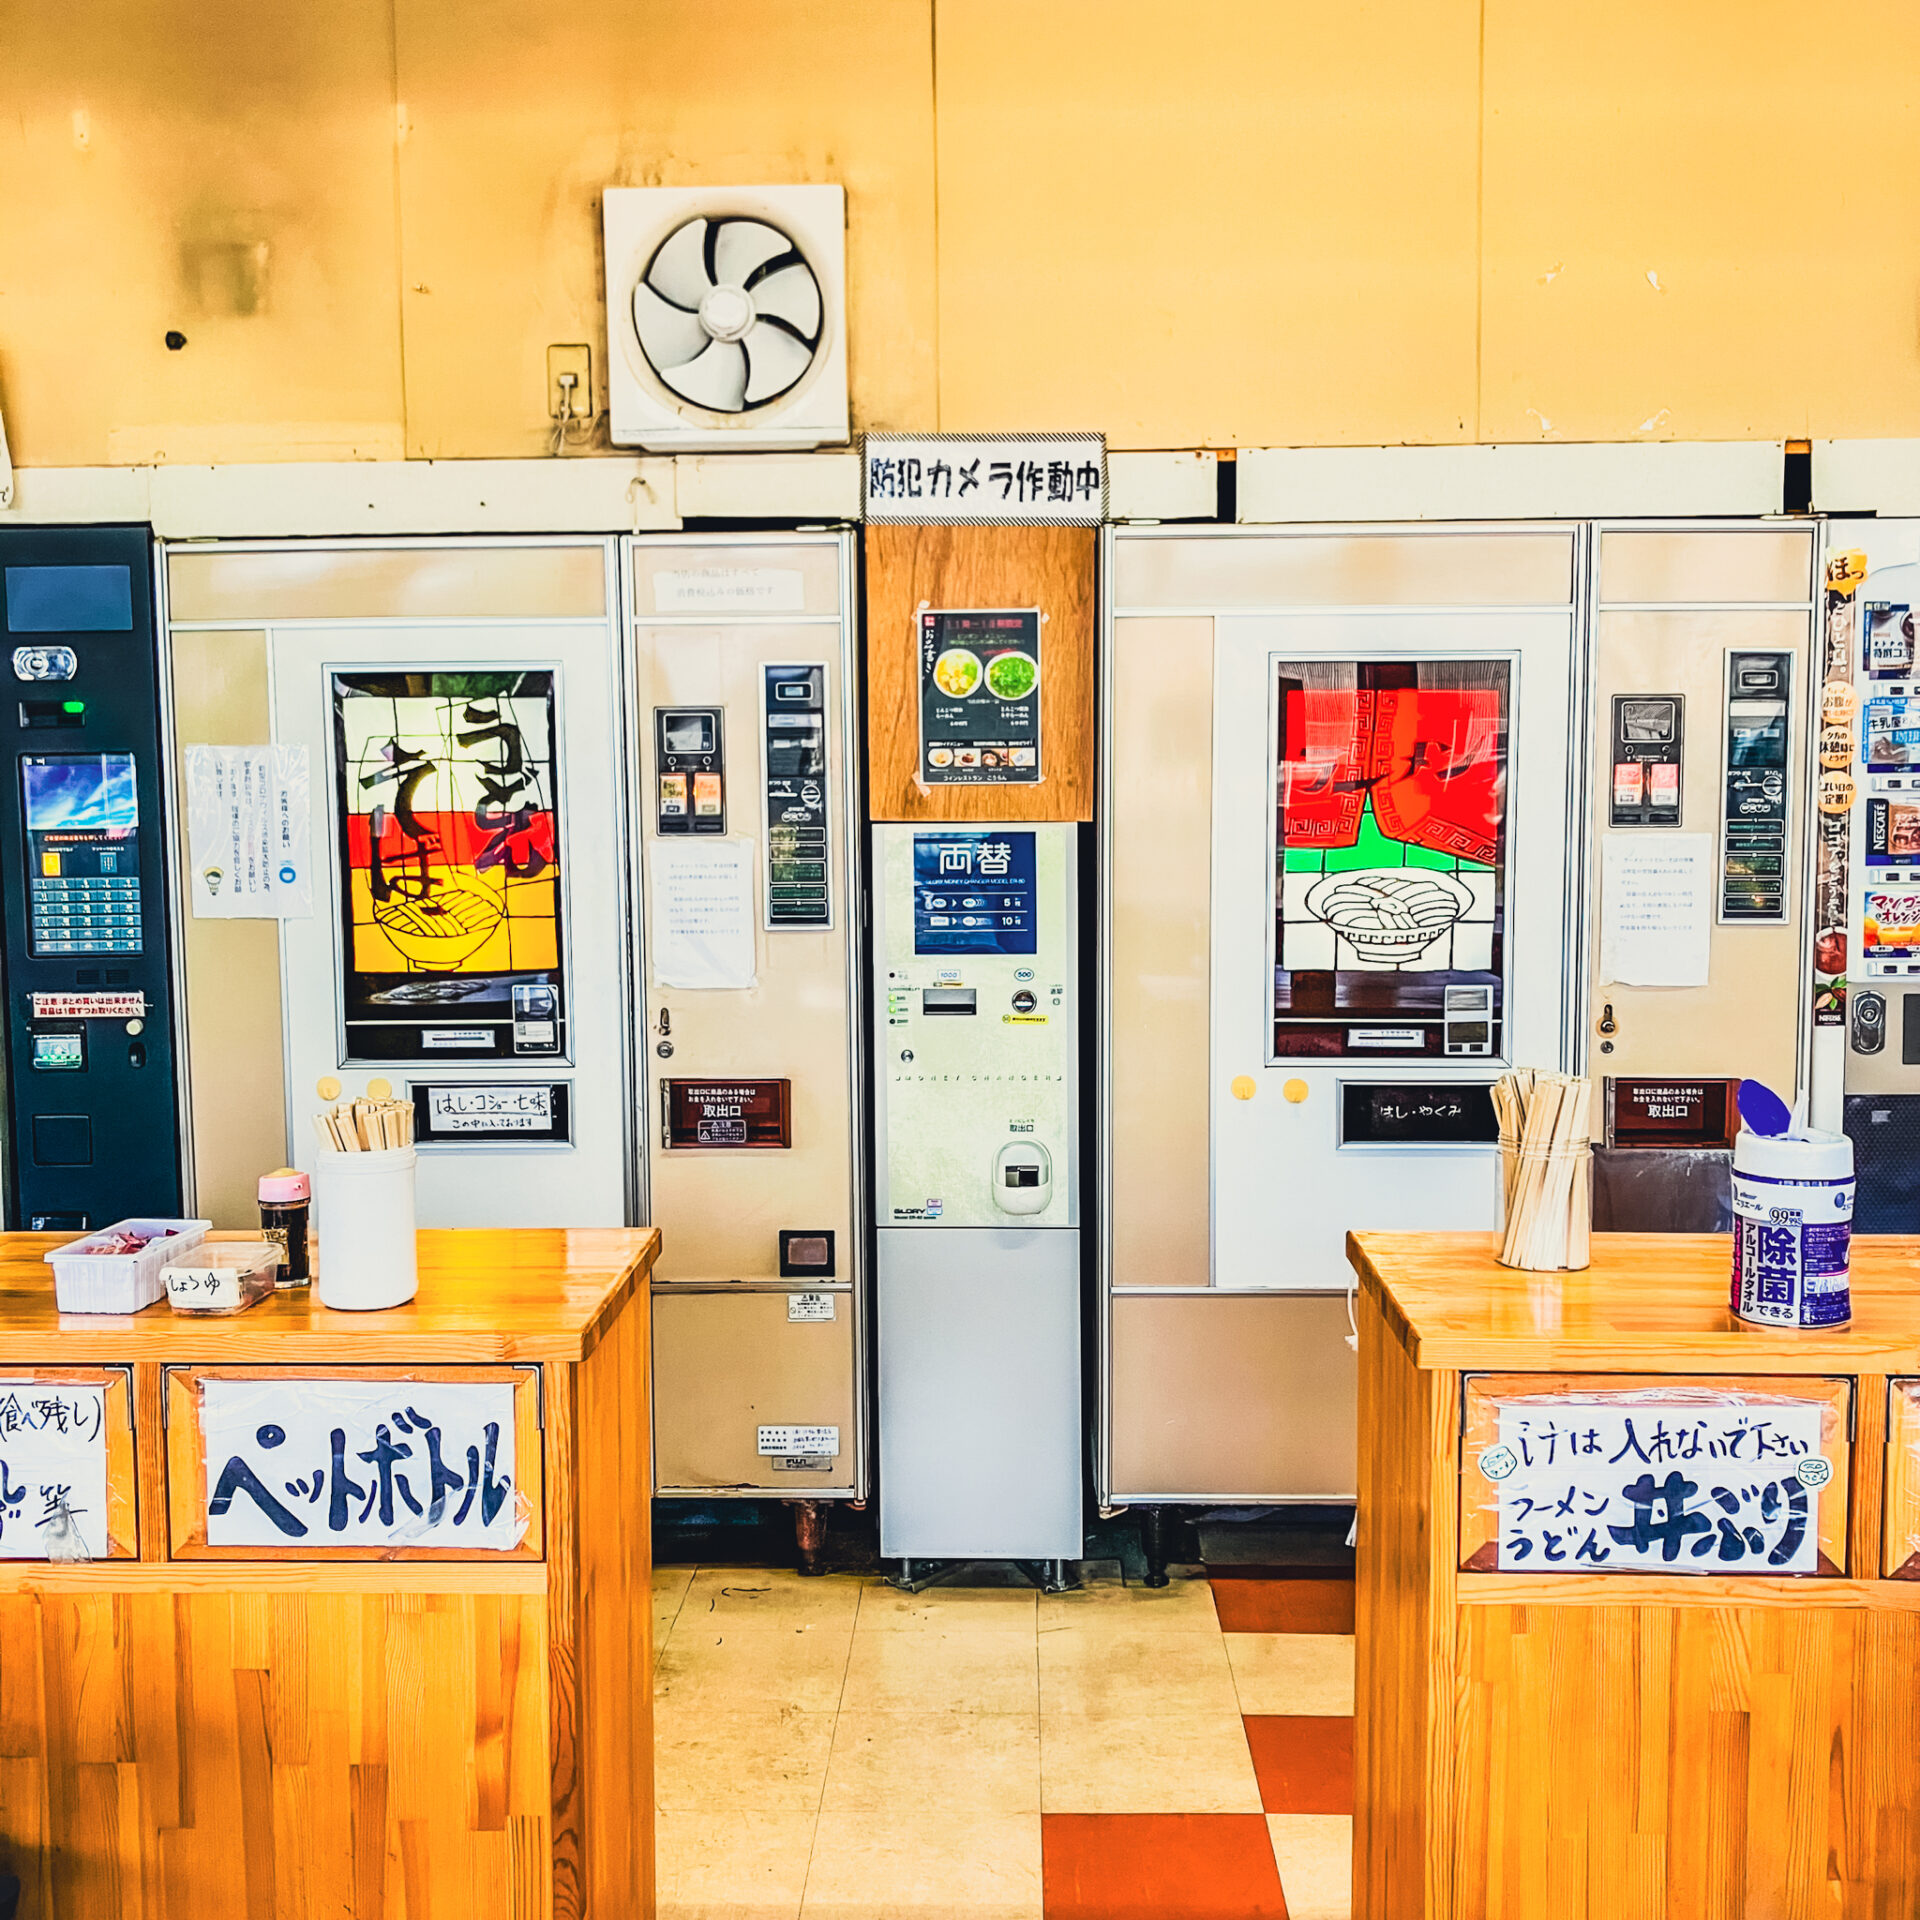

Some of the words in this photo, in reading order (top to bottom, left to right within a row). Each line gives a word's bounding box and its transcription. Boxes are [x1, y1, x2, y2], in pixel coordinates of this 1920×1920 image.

[870, 458, 1100, 502] 防犯カメラ作動中
[1873, 803, 1887, 850] NESCAFÉ
[939, 842, 1011, 875] 両替
[1002, 916, 1013, 925] 10
[940, 971, 958, 979] 1000
[703, 1104, 742, 1118] 取出口
[1648, 1104, 1689, 1118] 取出口
[1009, 1124, 1034, 1132] 取出口
[1742, 1222, 1756, 1313] アルコールタオル
[1757, 1226, 1797, 1307] 除菌
[167, 1272, 221, 1296] しょうゆ
[1756, 1303, 1794, 1319] できる
[208, 1406, 512, 1538] ペットボトル
[1508, 1485, 1610, 1518] ラーメン
[1505, 1528, 1612, 1562] うどん
